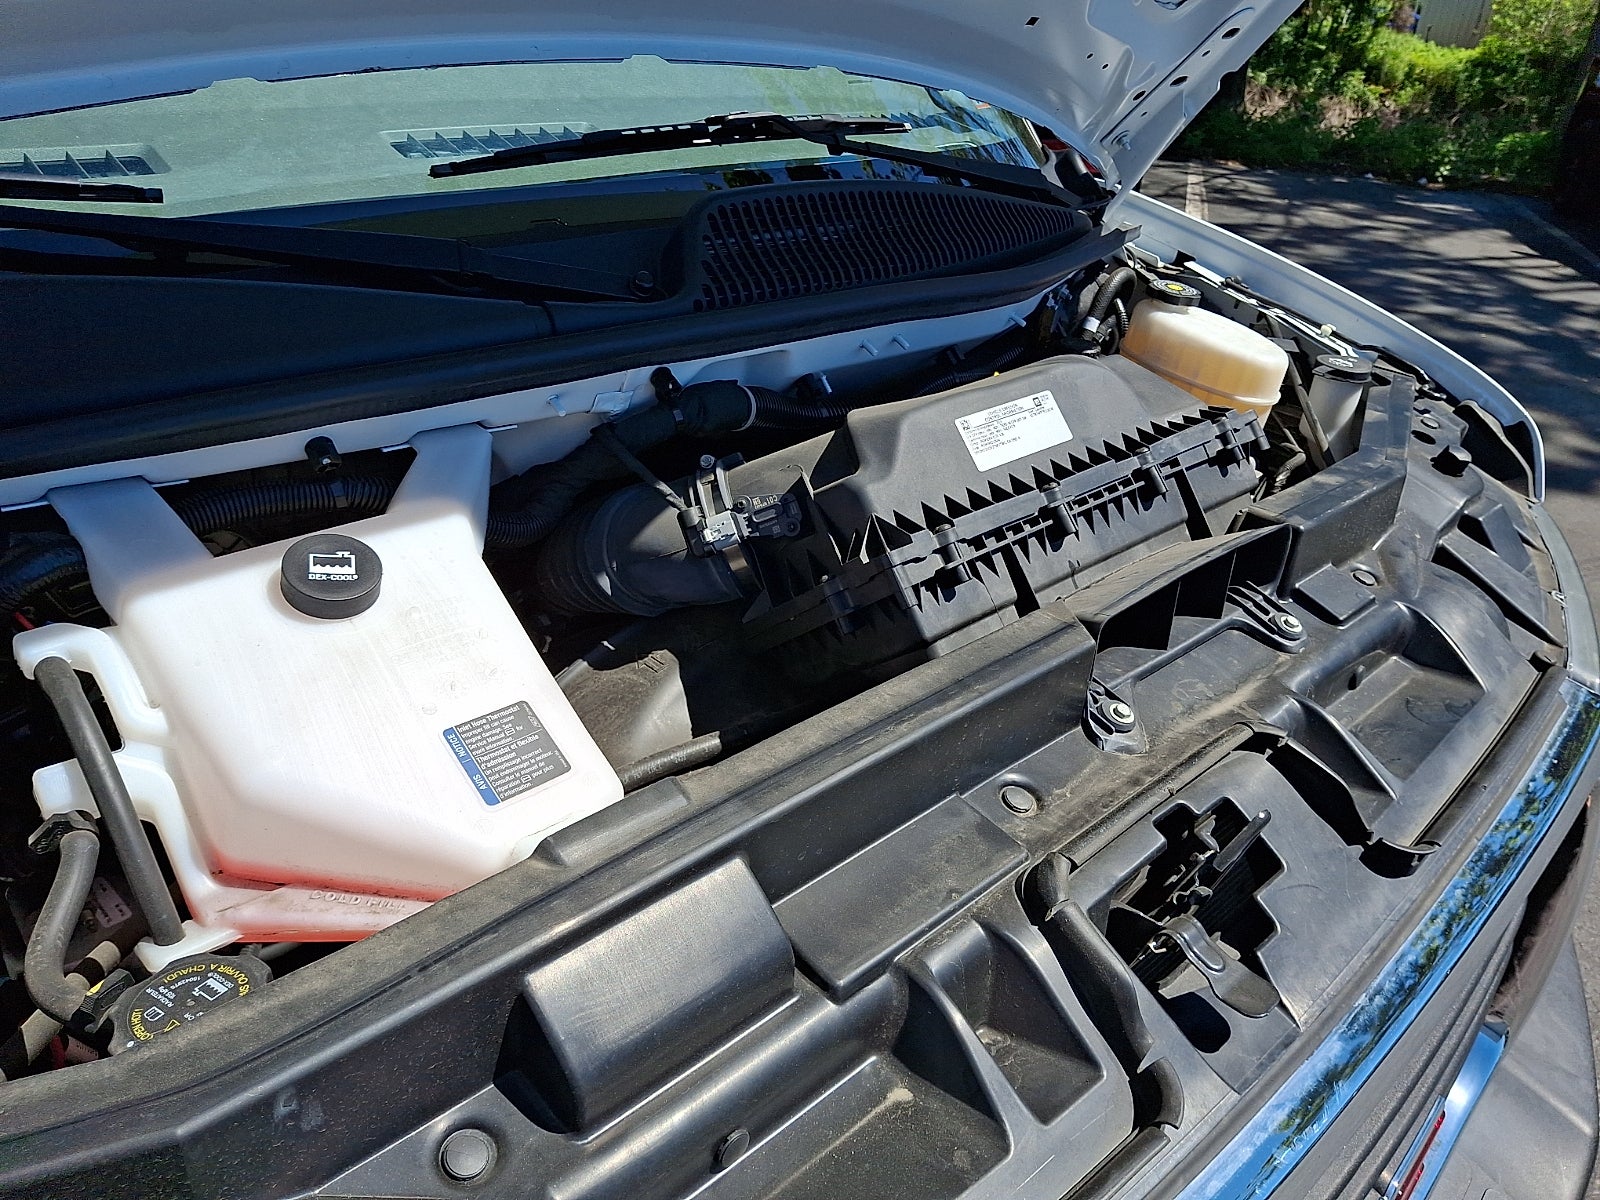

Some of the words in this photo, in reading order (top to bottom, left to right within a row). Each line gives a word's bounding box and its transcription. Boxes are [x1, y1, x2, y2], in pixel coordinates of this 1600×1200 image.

[471, 718, 488, 728] Hose
[486, 705, 520, 722] Thermostat
[447, 733, 467, 757] NOTICE
[476, 745, 511, 764] Thermostat
[473, 774, 487, 790] AVIS
[218, 963, 250, 984] OUVRIR
[145, 986, 175, 1008] RADIATEUR
